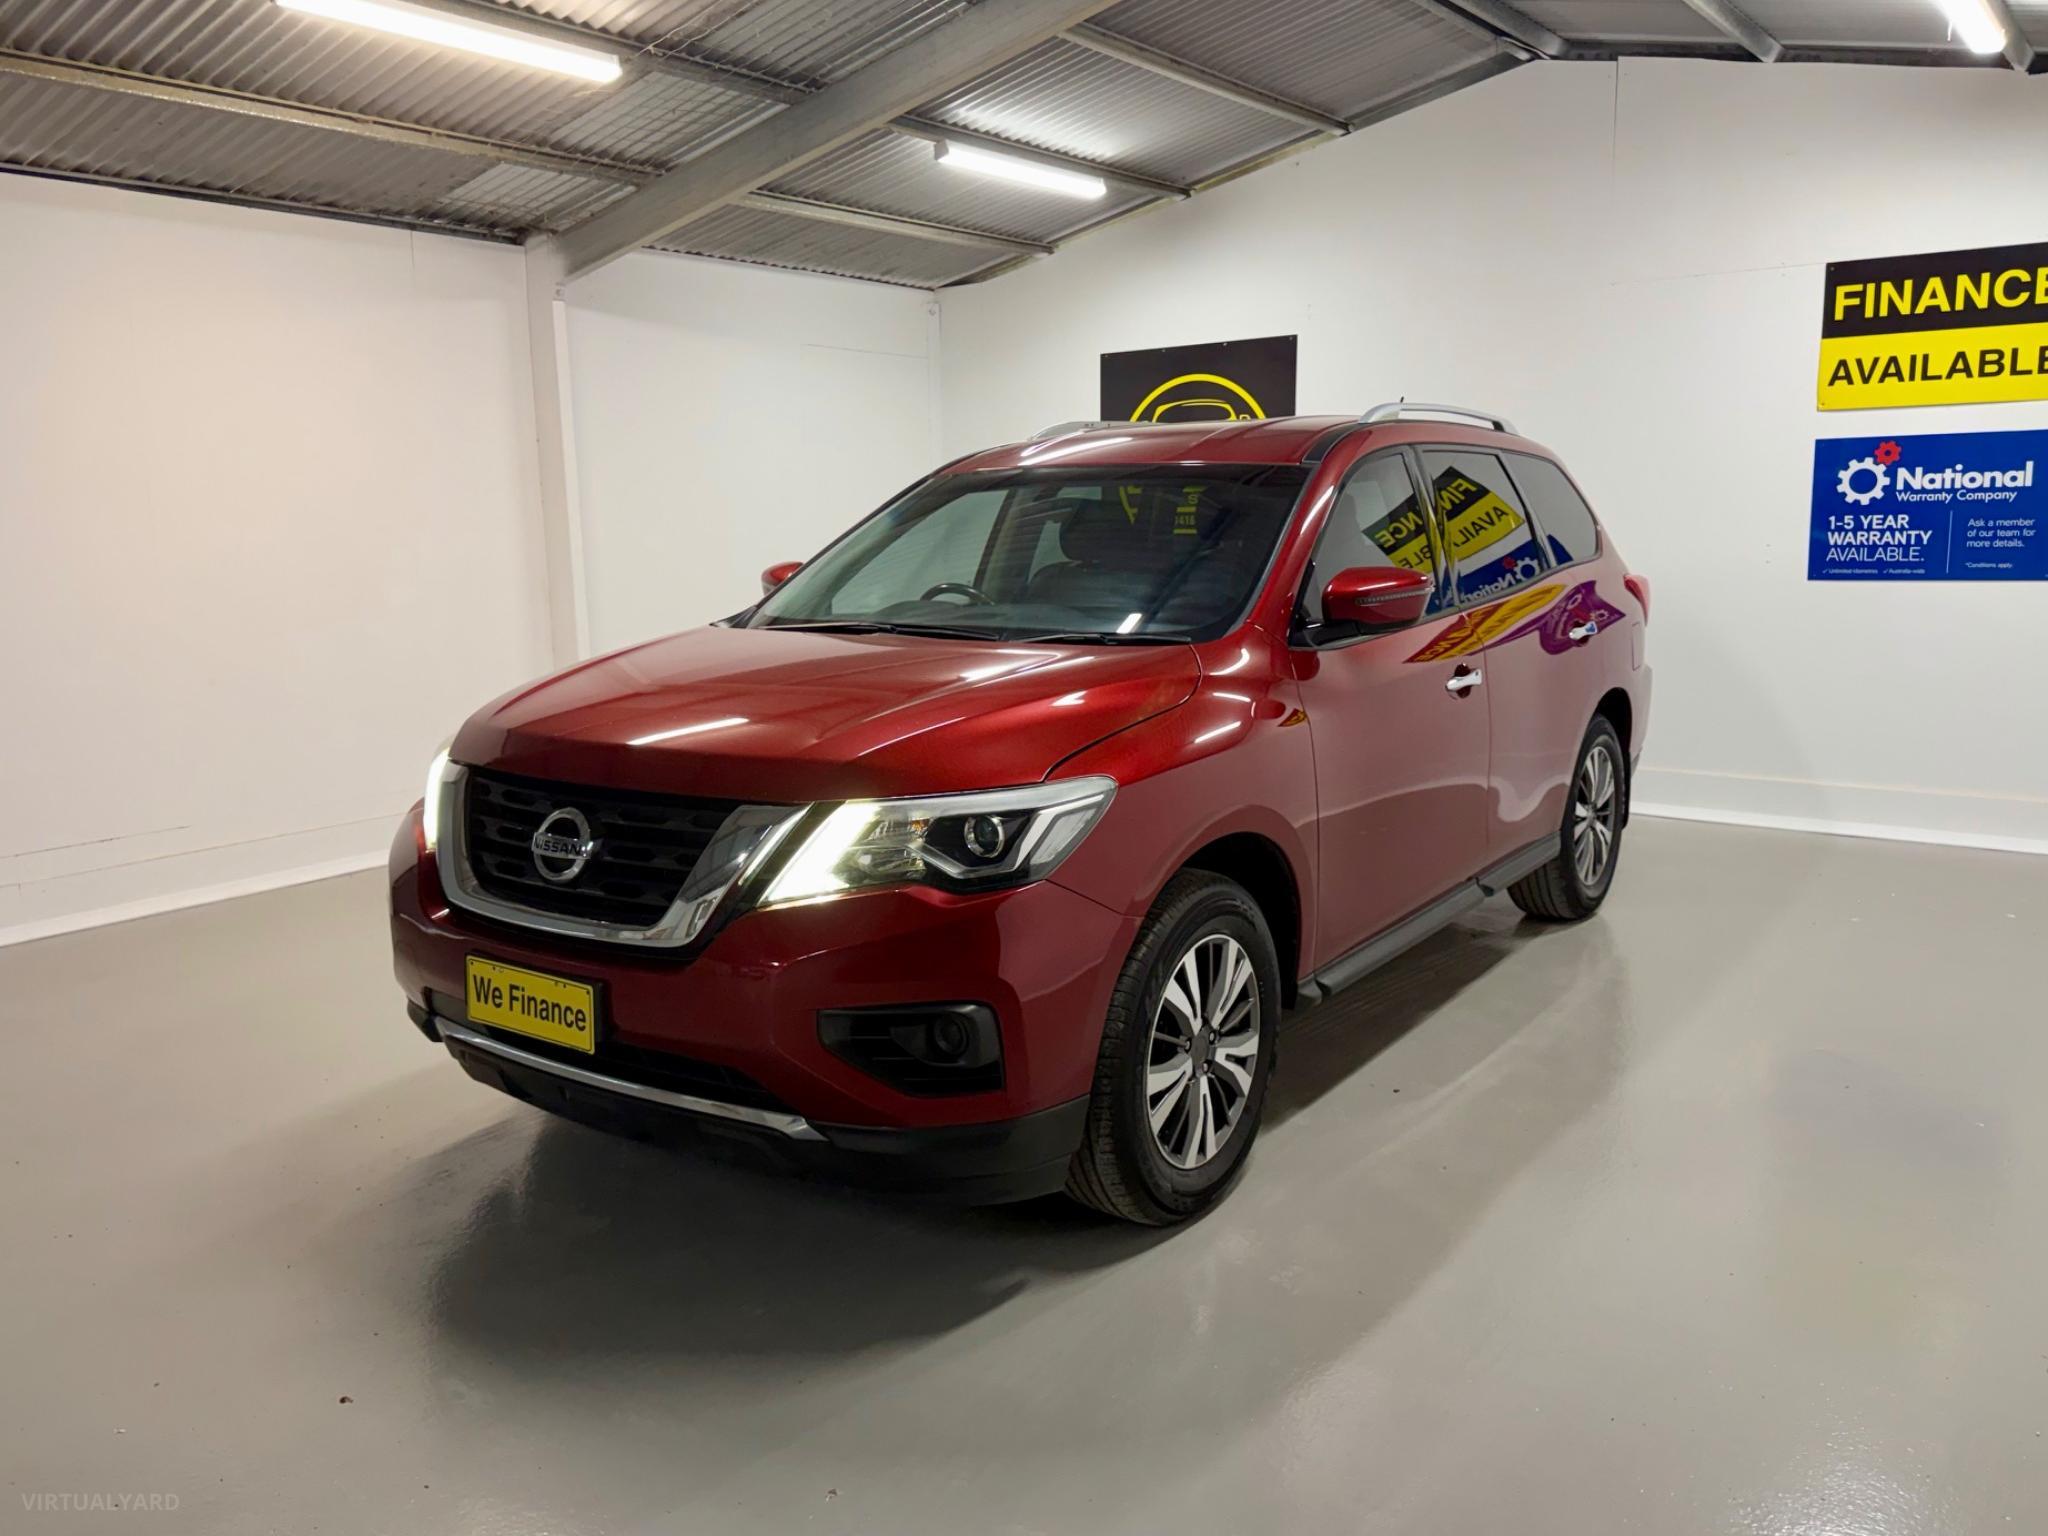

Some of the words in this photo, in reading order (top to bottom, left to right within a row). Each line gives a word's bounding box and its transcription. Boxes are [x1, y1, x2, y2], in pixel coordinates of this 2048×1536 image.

[1896, 460, 2034, 490] National
[1895, 491, 1953, 504] Warranty
[1956, 489, 2017, 503] Company
[1828, 515, 1854, 530] 1-5
[1860, 514, 1909, 529] YEAR
[1967, 518, 1985, 527] Ask
[1996, 518, 2036, 527] member
[1827, 530, 1933, 545] WARRANTY
[1967, 529, 1977, 537] of
[1997, 529, 2020, 537] team
[2023, 528, 2037, 537] for
[1966, 540, 1991, 548] more
[1992, 538, 2025, 548] details.
[1826, 546, 1925, 562] AVAILABLE.
[534, 836, 580, 855] NISSAN
[473, 974, 503, 1008] We
[508, 984, 587, 1032] Finance
